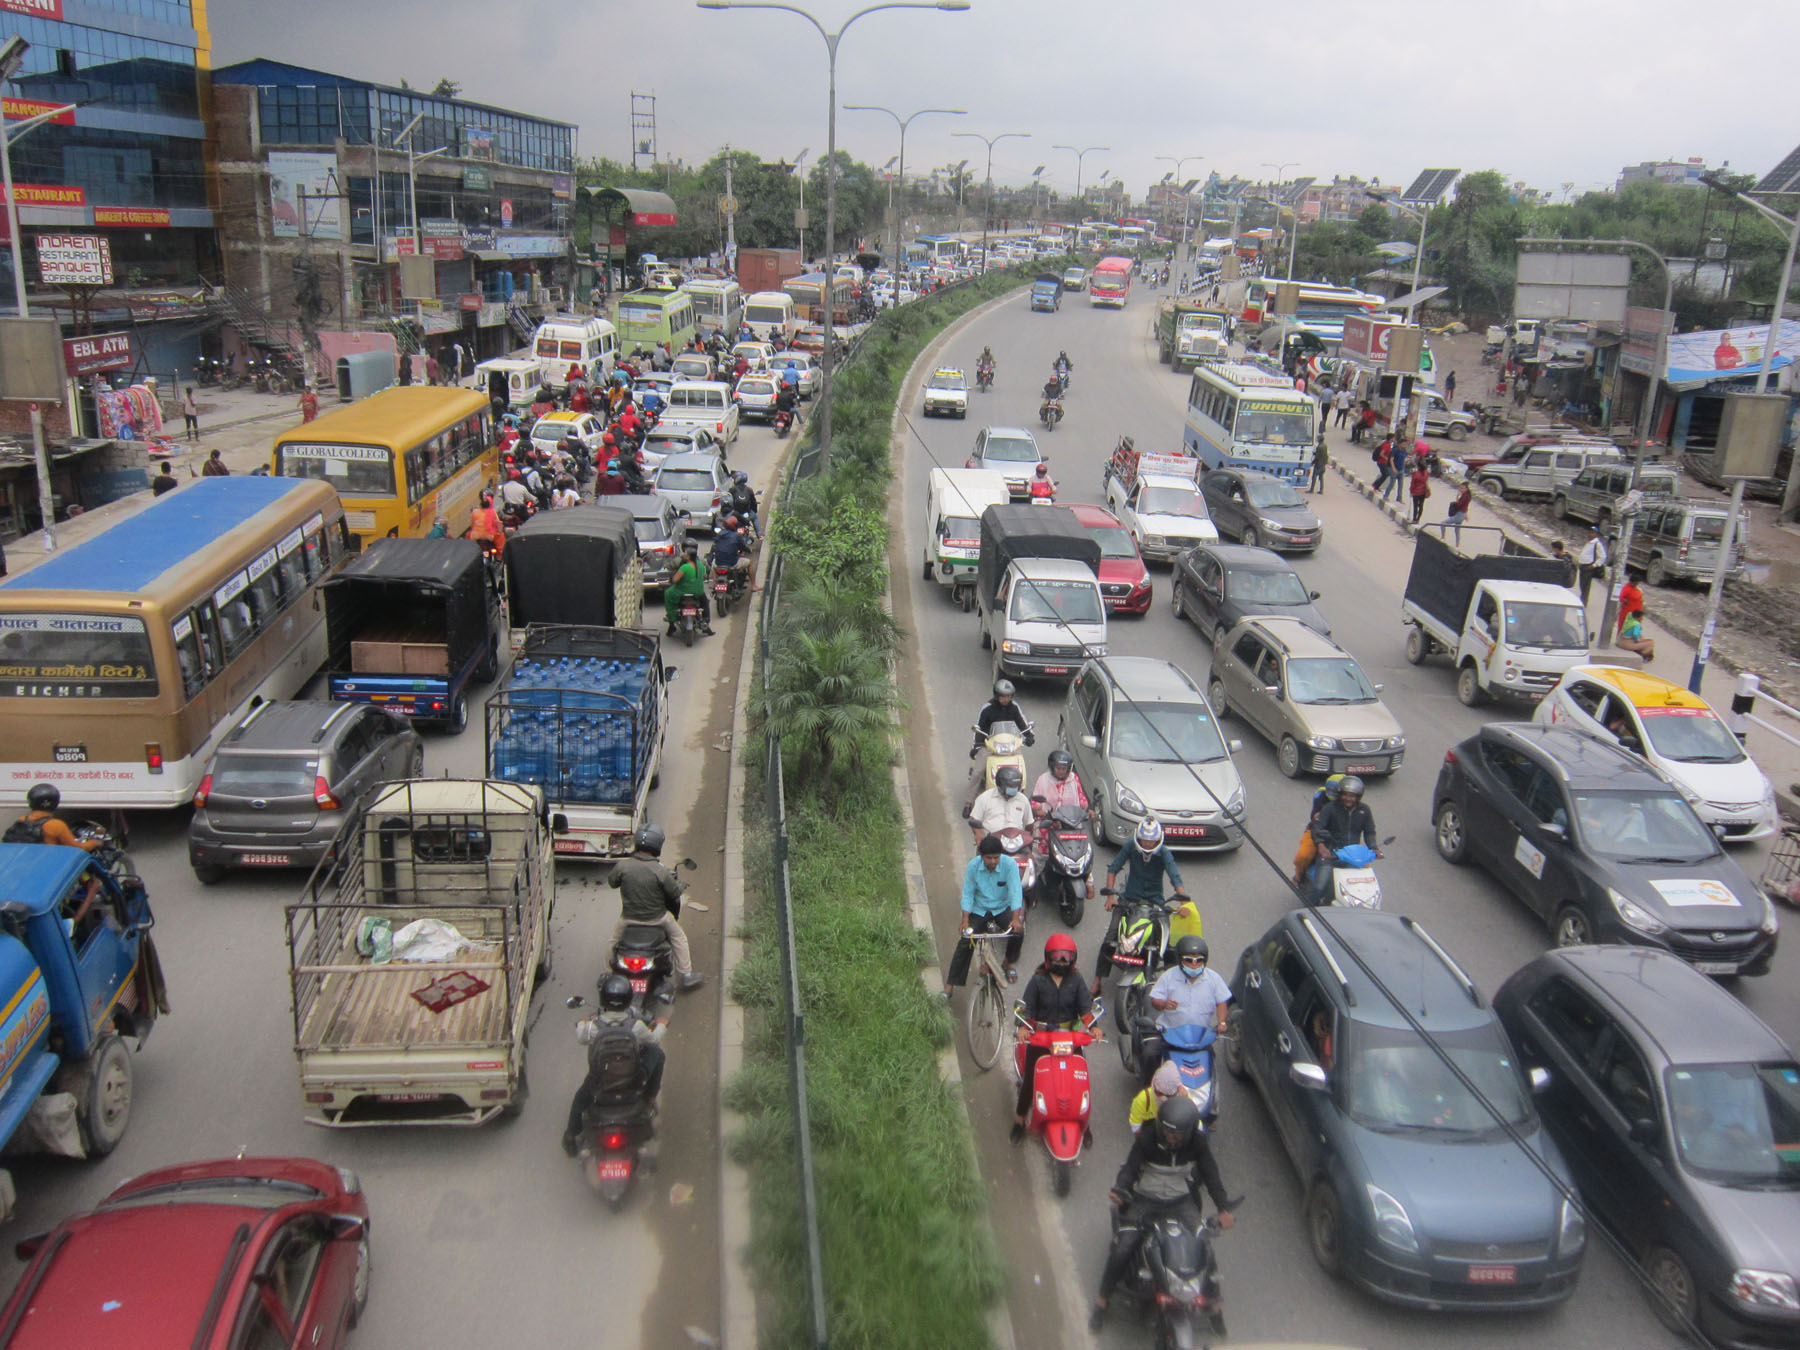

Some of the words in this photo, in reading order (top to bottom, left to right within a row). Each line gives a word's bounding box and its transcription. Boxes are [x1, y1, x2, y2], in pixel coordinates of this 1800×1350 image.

[37, 235, 99, 249] INDRENI
[39, 250, 99, 260] RESTAURANT
[40, 262, 100, 273] BANQUET
[42, 273, 78, 283] COFFEE
[79, 274, 102, 284] SHOP
[72, 341, 100, 358] EBL
[102, 336, 130, 354] ATM
[1250, 402, 1304, 413] UNIQUE
[296, 446, 338, 458] GLOBAL
[339, 448, 387, 460] COLLEGE
[49, 620, 123, 632] यातायात
[16, 685, 102, 697] EICHER
